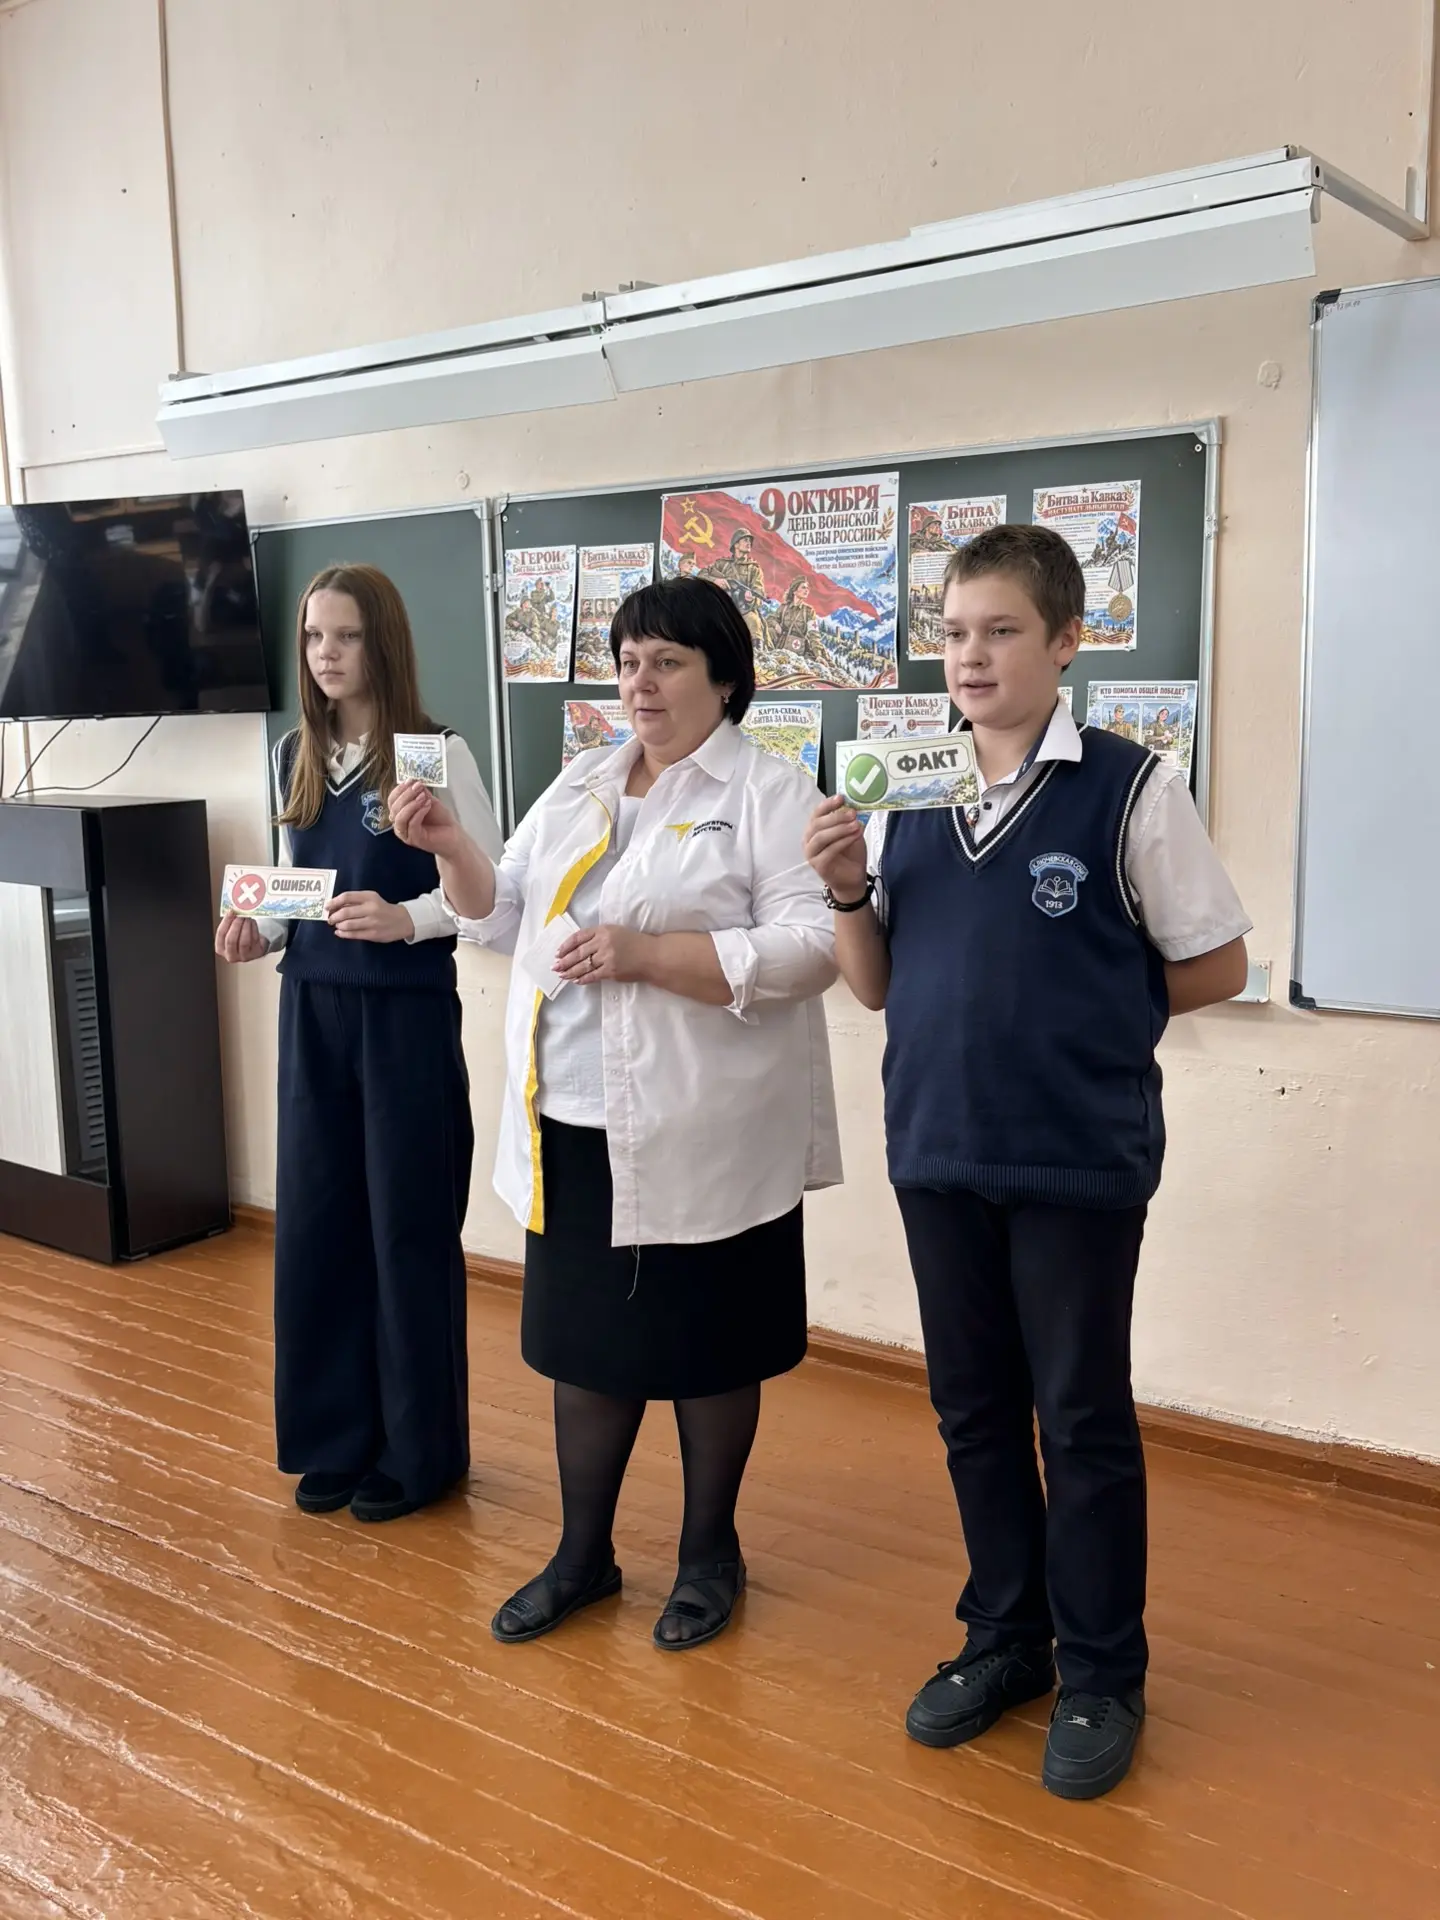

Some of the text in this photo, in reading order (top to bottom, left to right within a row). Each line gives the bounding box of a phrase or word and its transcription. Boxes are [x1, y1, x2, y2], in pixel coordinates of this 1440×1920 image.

[759, 488, 786, 532] 9
[787, 509, 879, 533] ДЕНЬ ВОИНСКОЙ
[959, 516, 999, 528] КАВКАЗ
[792, 527, 876, 547] СЛАВЫ РОССИИ
[520, 551, 561, 566] ГЕРОИ
[1100, 687, 1112, 695] КТО
[1138, 686, 1159, 695] ОБЩЕЙ
[1160, 687, 1186, 695] ПОБЕДЕ?
[758, 707, 801, 716] КАРТА-СХЕМА
[897, 749, 958, 773] ФАКТ
[271, 879, 322, 892] ОШИБКА
[1045, 900, 1063, 909] 1913
